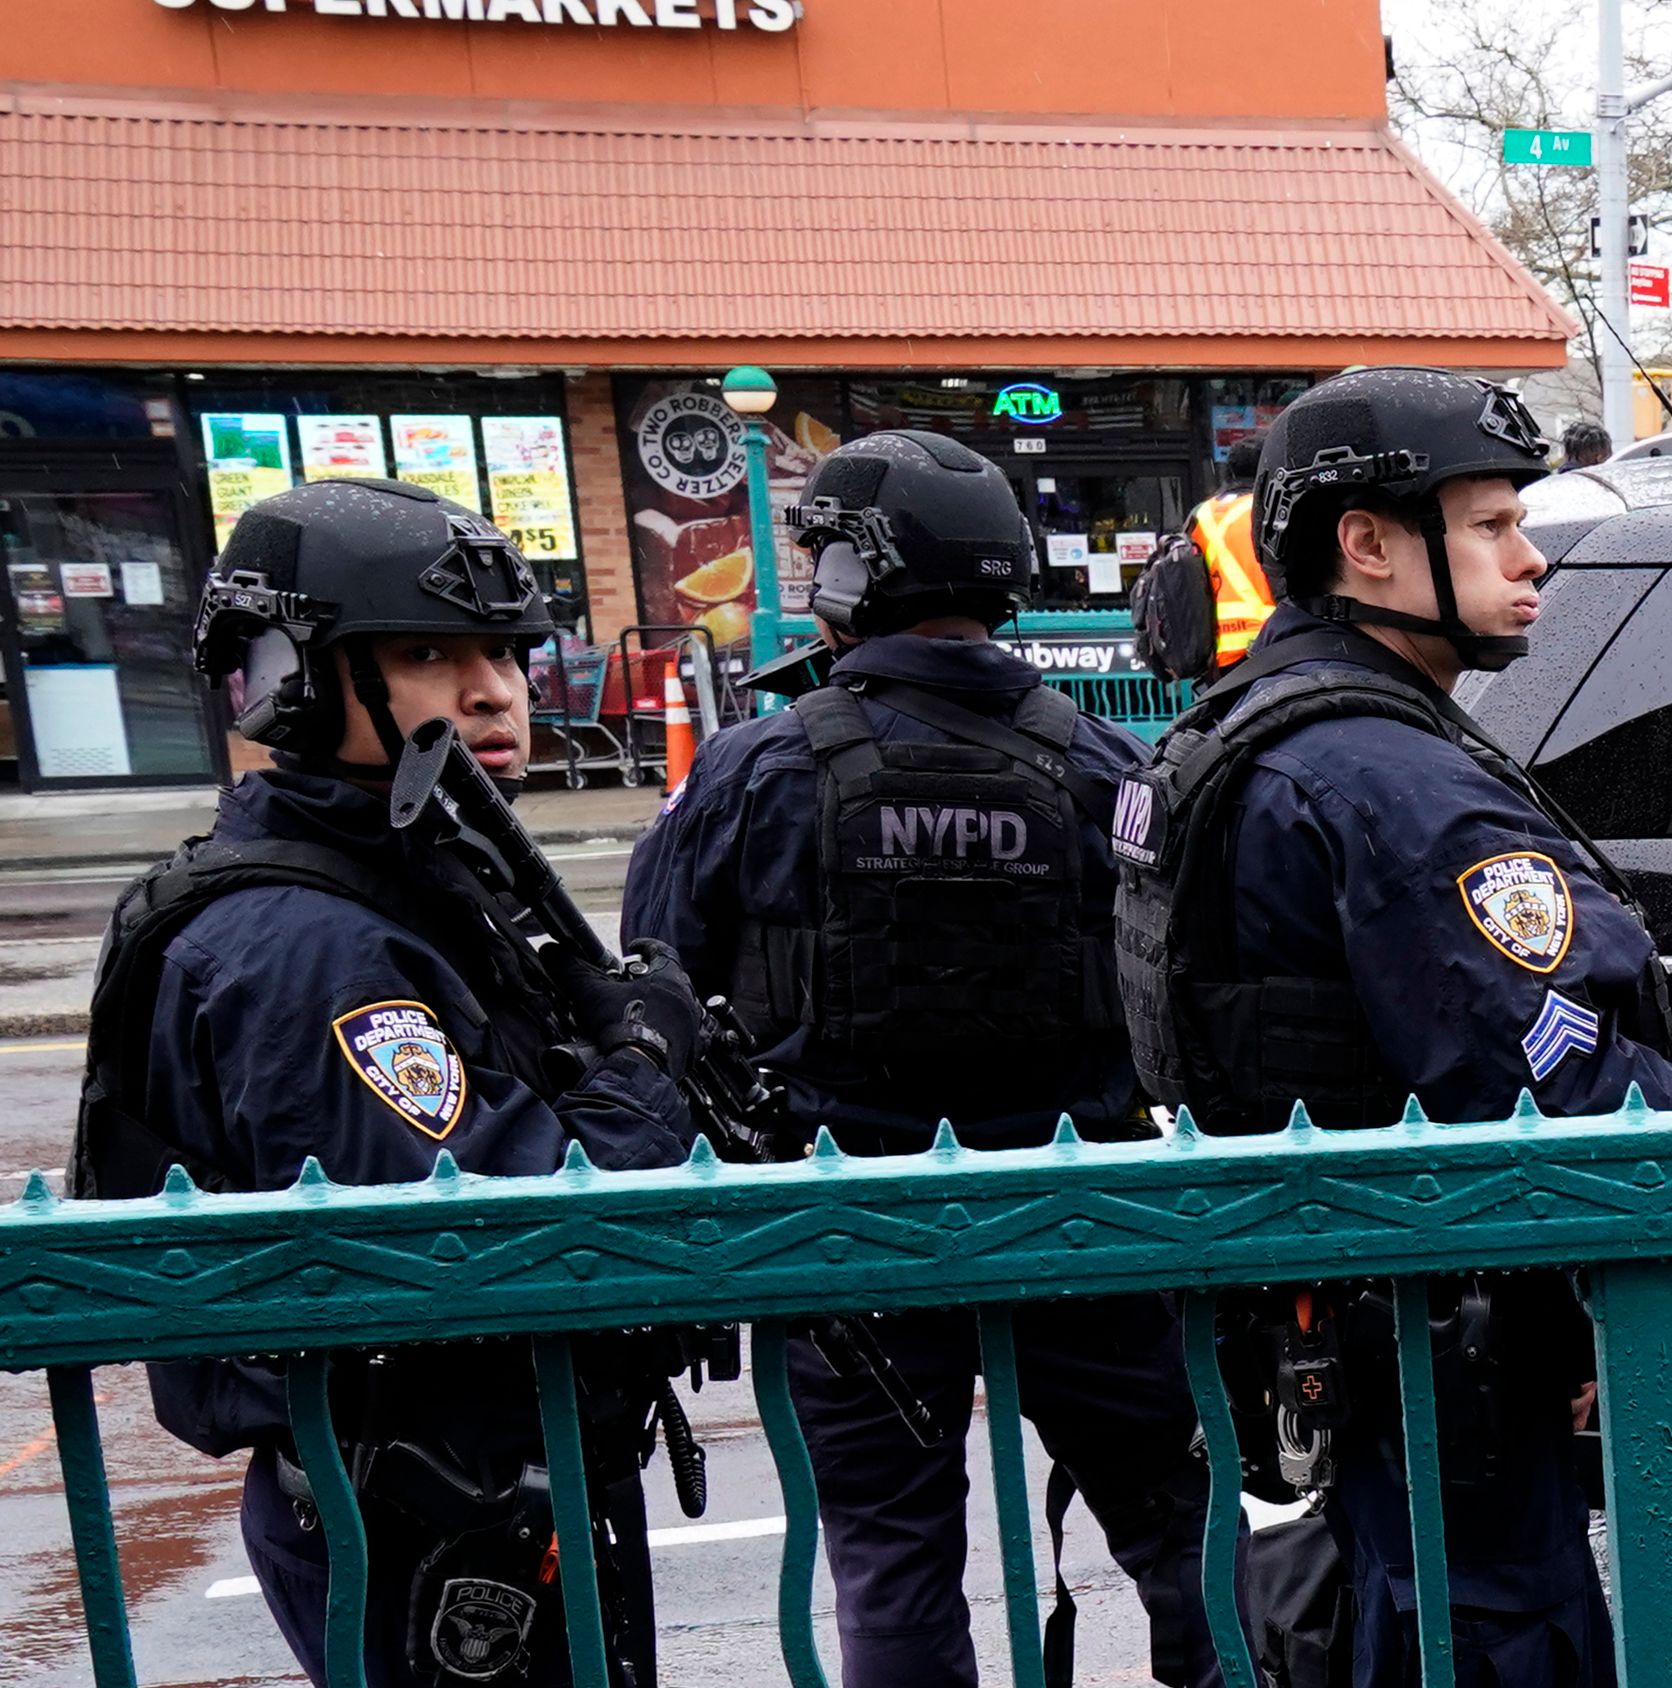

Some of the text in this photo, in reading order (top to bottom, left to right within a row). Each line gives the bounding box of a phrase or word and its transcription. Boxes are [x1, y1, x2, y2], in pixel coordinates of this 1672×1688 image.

[1530, 135, 1569, 159] 4 Av
[993, 392, 1060, 416] ATM
[643, 409, 667, 446] TWO
[669, 396, 742, 446] ROBBERS
[1017, 441, 1043, 451] 760
[676, 451, 745, 493] SELTZER
[1318, 470, 1337, 482] 832
[980, 559, 1013, 577] SRG
[881, 805, 1028, 860] NYPD
[1004, 861, 1050, 876] GROUP
[1483, 858, 1533, 881] POLICE
[1471, 870, 1555, 905] DEPARTMENT
[1483, 917, 1531, 957] CITY OF
[1547, 893, 1567, 957] NEW YORK
[370, 1010, 428, 1029] POLICE
[354, 1024, 447, 1051] DEPARTMENT
[366, 1065, 421, 1116] CITY OF
[456, 1586, 523, 1615] POLICE
